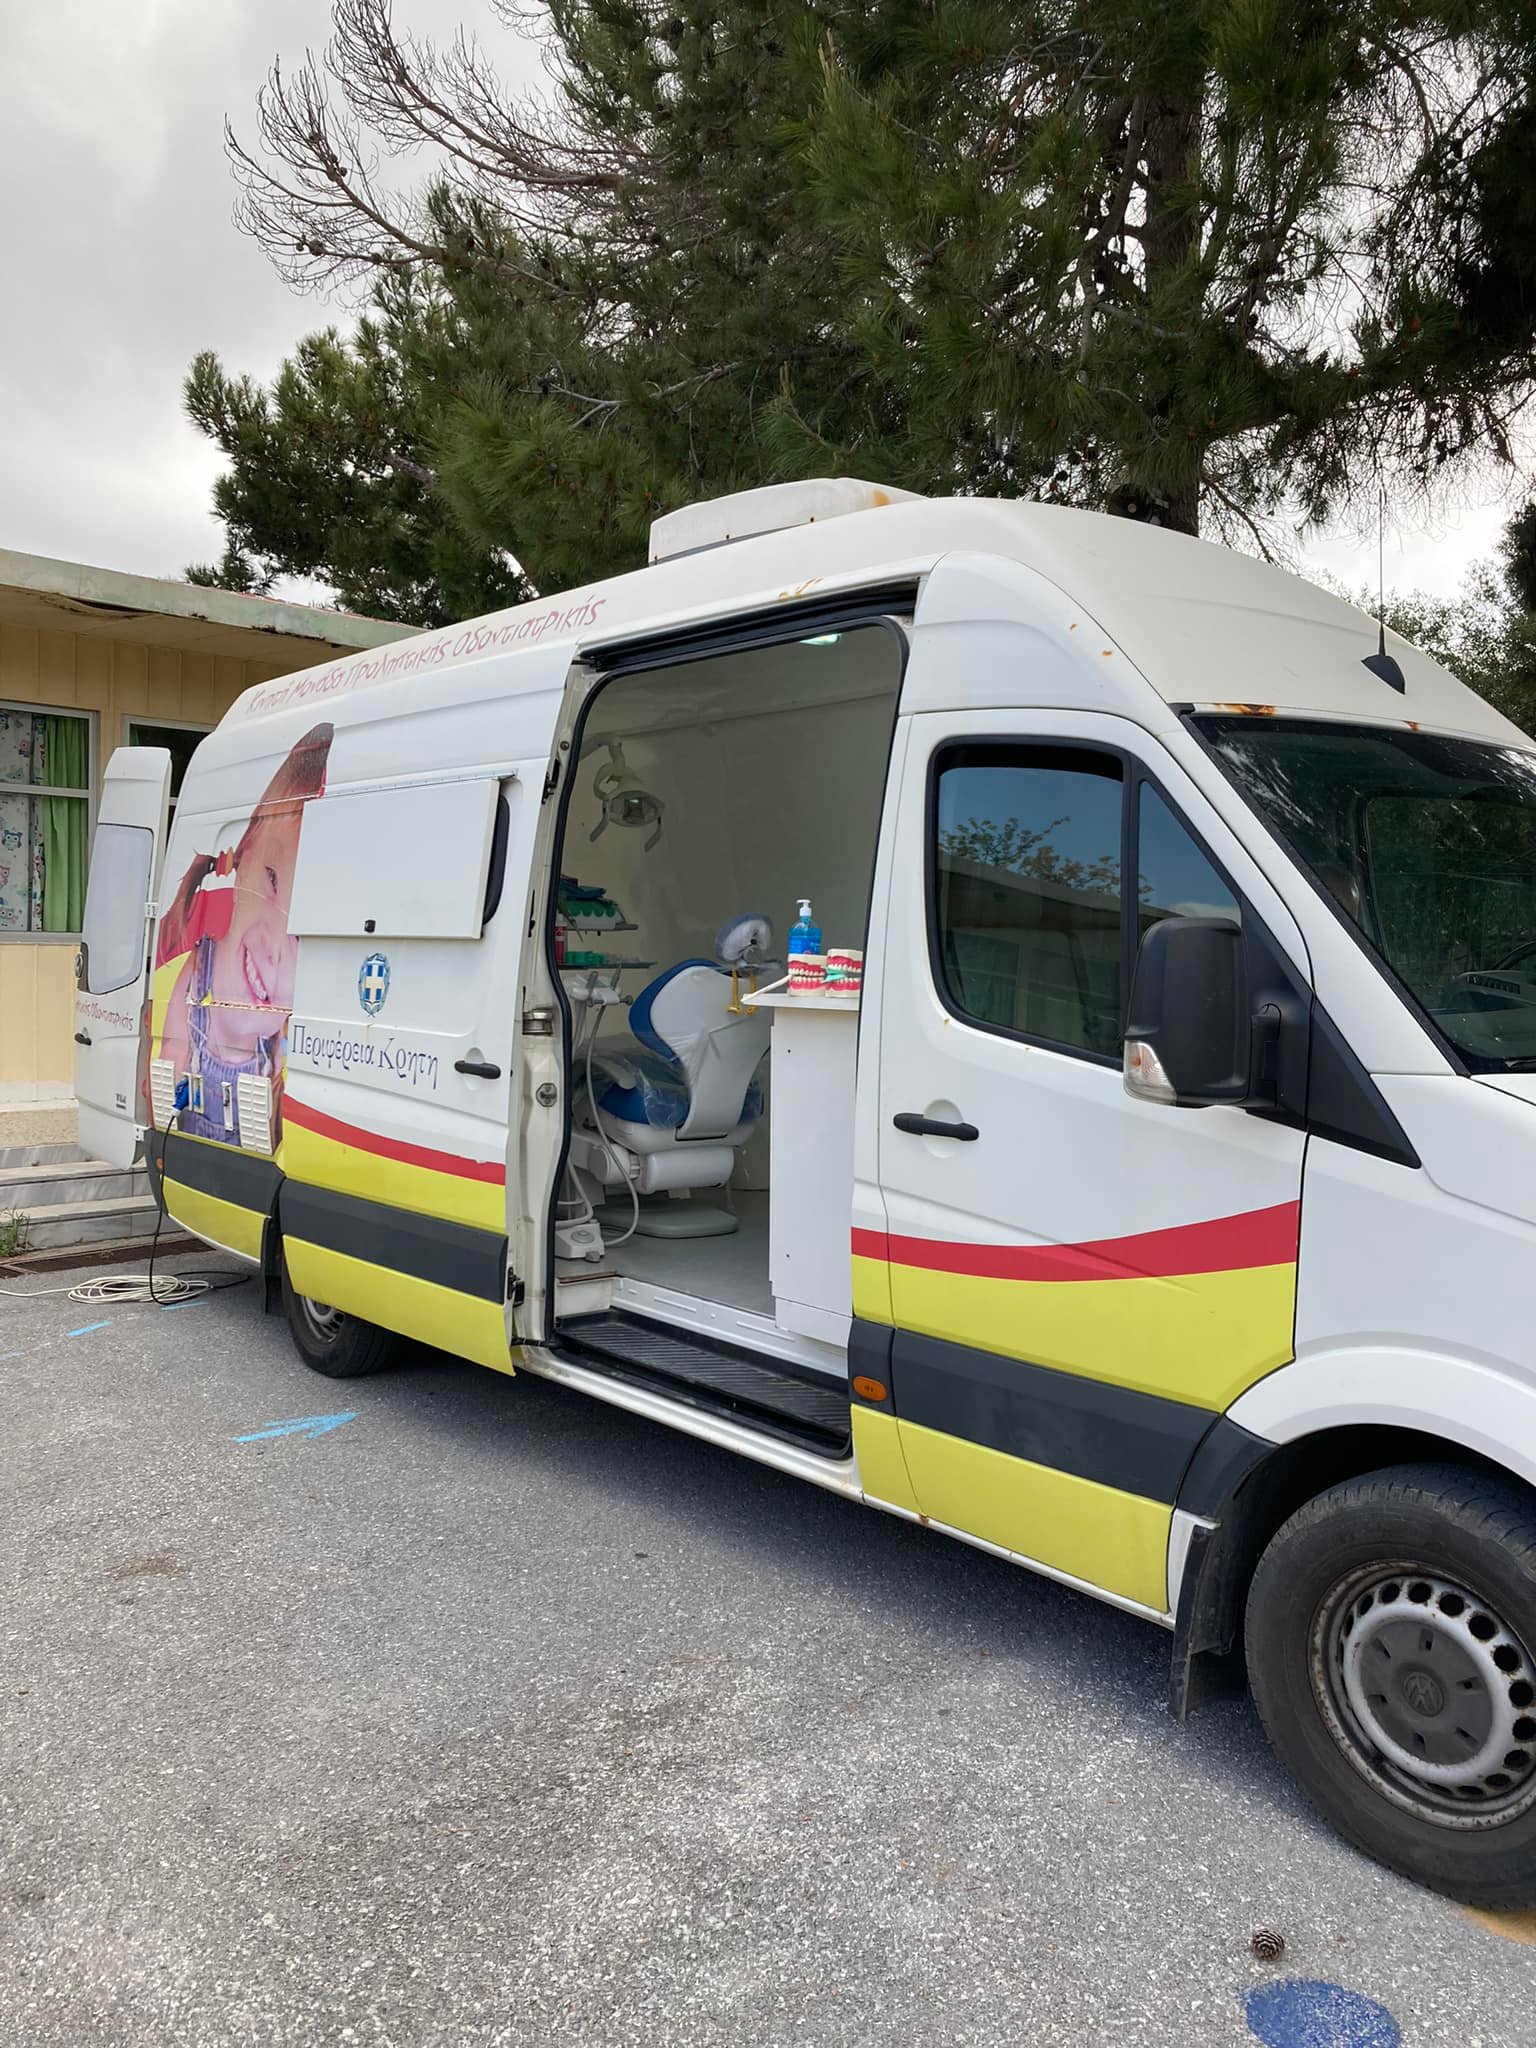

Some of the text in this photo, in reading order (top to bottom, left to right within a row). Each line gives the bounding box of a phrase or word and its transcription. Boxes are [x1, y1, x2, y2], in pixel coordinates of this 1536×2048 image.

[345, 636, 453, 688] Προληπτικής
[453, 594, 606, 656] Οδοντιατρικής
[292, 1025, 375, 1071] Περιφέρεια
